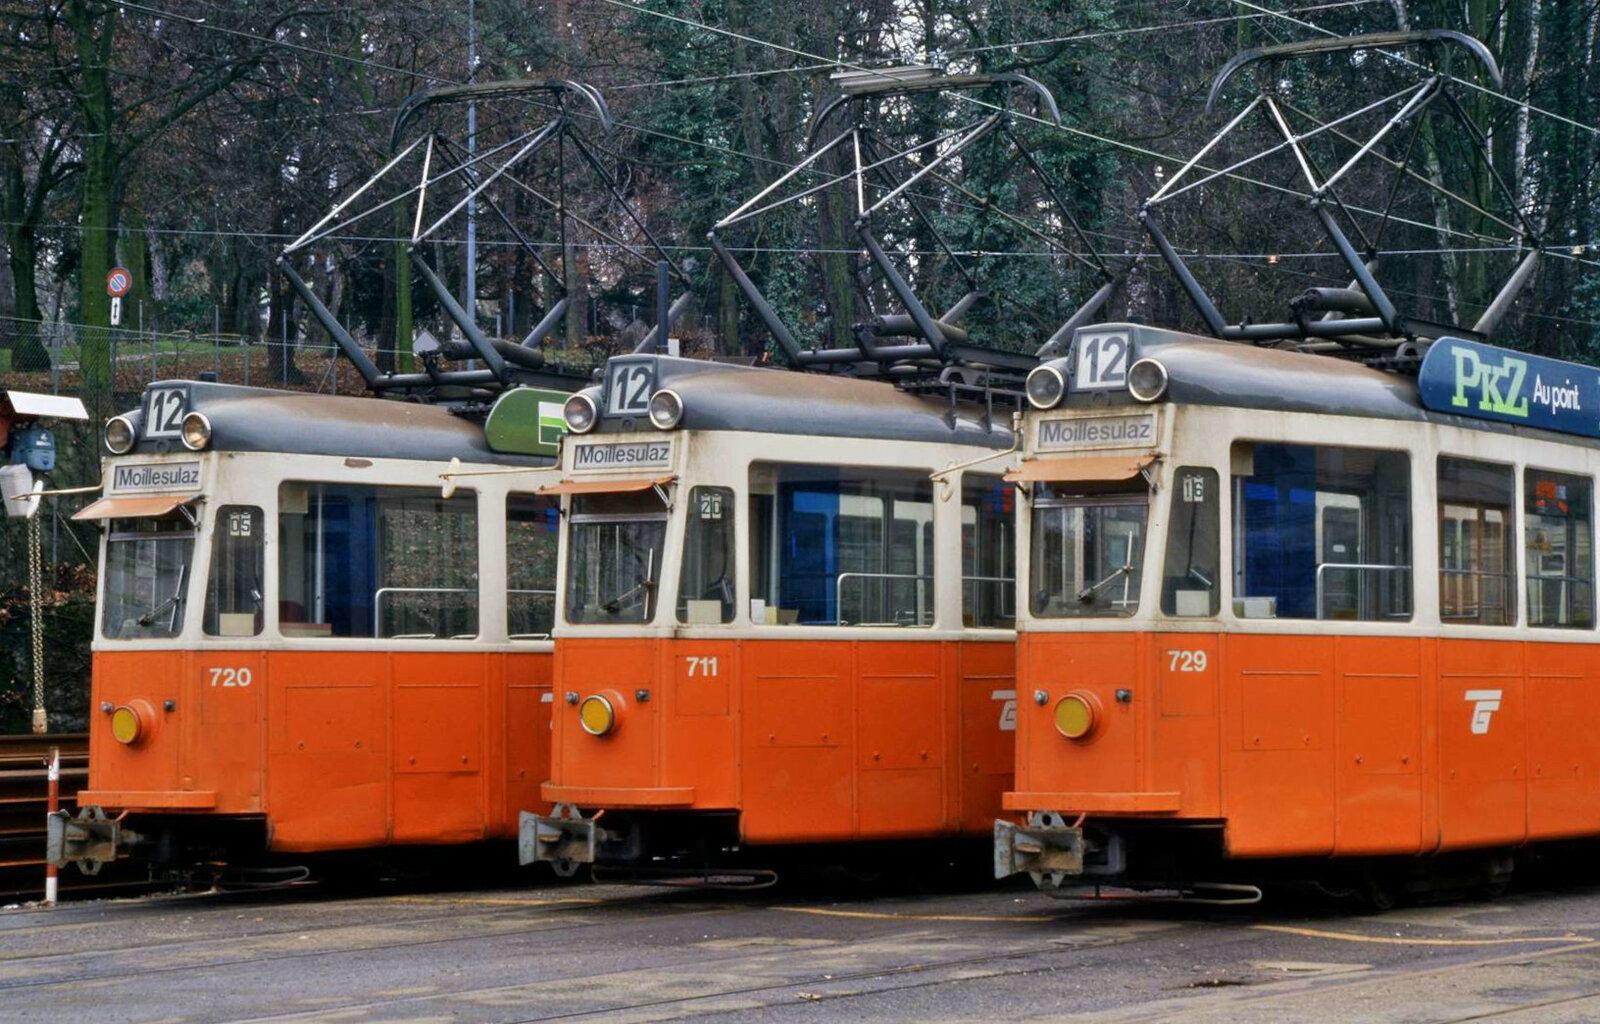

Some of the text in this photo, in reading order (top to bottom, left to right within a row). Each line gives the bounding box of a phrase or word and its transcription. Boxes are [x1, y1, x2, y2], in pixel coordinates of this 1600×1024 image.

[1086, 336, 1127, 383] 12
[617, 367, 652, 410] 12
[1533, 373, 1550, 405] Au
[1552, 379, 1581, 415] point.
[153, 390, 186, 432] 12
[1043, 420, 1150, 443] Moillesulaz
[579, 444, 670, 464] Moillesulaz
[119, 467, 199, 487] Moillesulaz
[1185, 481, 1203, 498] 16
[702, 500, 721, 515] 20
[686, 657, 717, 676] 711
[1168, 650, 1207, 671] 729
[209, 668, 252, 687] 720
